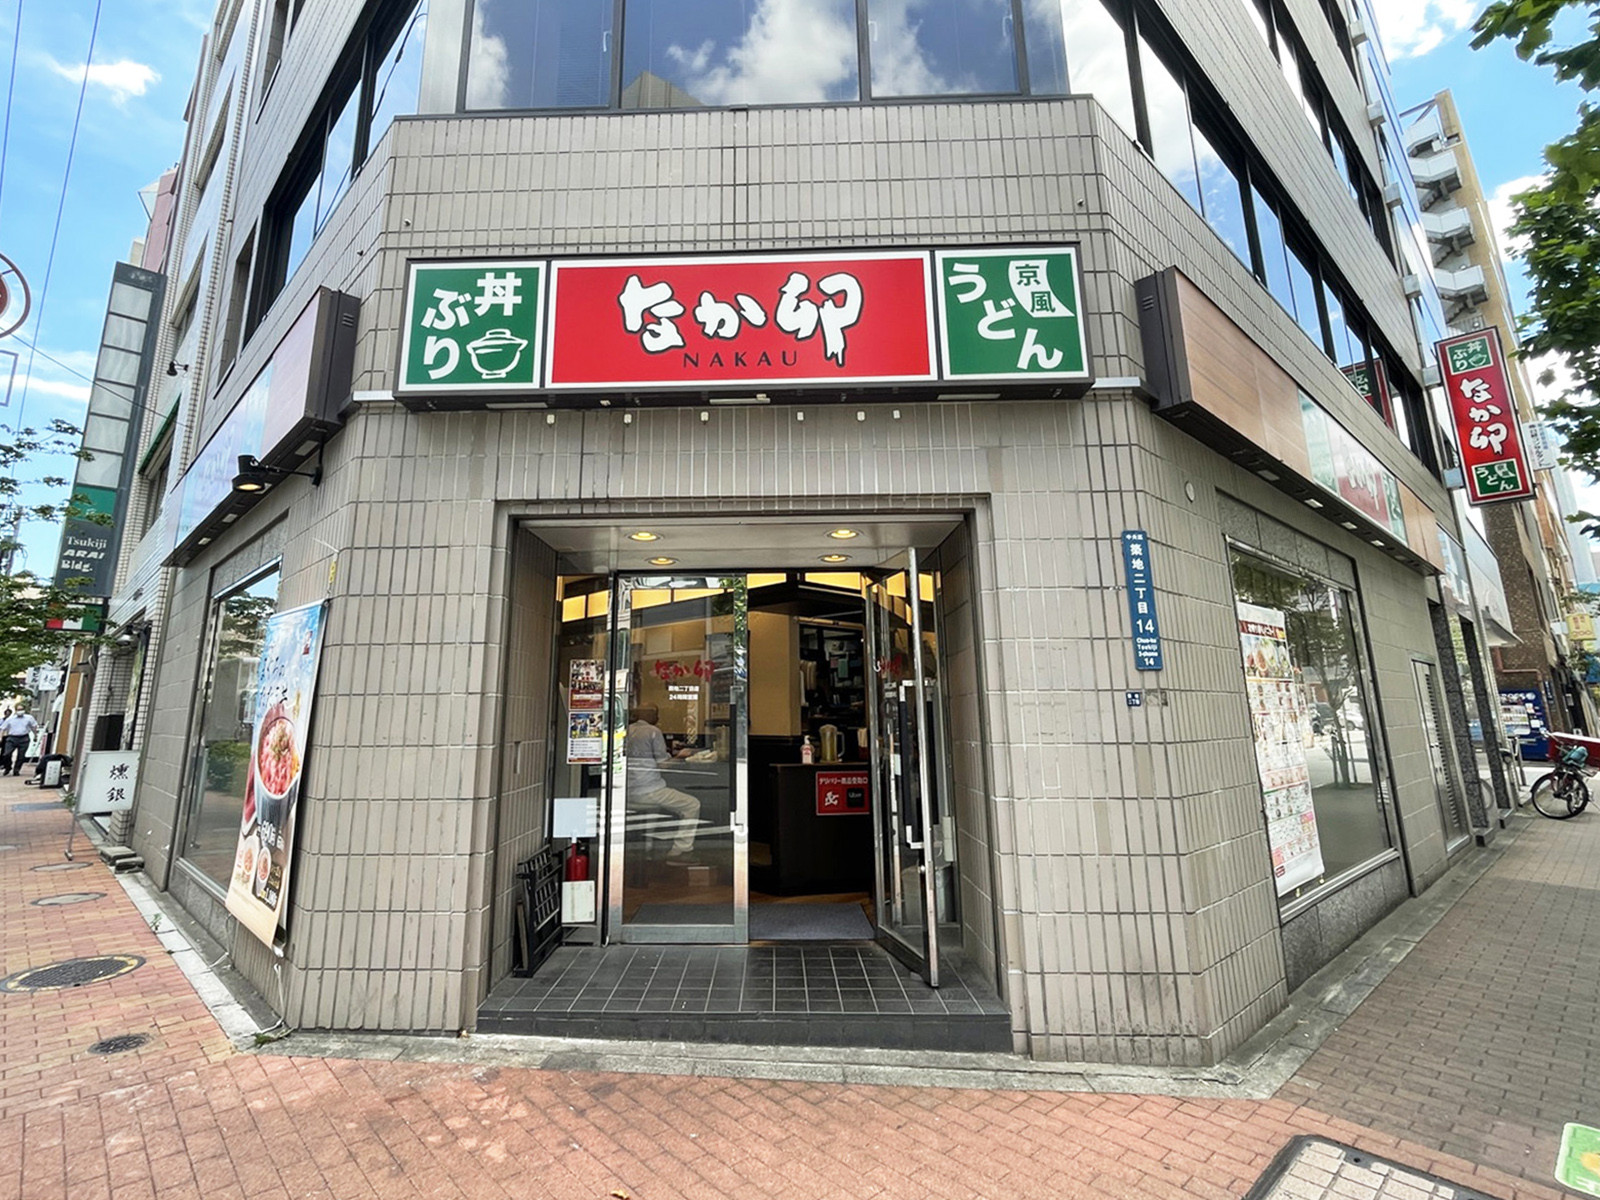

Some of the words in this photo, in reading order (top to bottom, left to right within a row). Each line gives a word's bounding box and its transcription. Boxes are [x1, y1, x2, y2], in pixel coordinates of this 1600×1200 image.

[1015, 264, 1056, 313] 京風
[617, 271, 864, 368] なか卯
[948, 262, 1064, 370] うどん
[683, 350, 798, 369] NAKAU
[1460, 377, 1508, 455] なか卯
[1476, 467, 1514, 491] うどん
[67, 536, 107, 550] Tsukiji
[63, 549, 105, 559] ARAI
[61, 560, 93, 572] Bldg.
[1130, 543, 1148, 614] 築地二丁目
[1136, 619, 1154, 633] 14
[1144, 658, 1155, 666] 14
